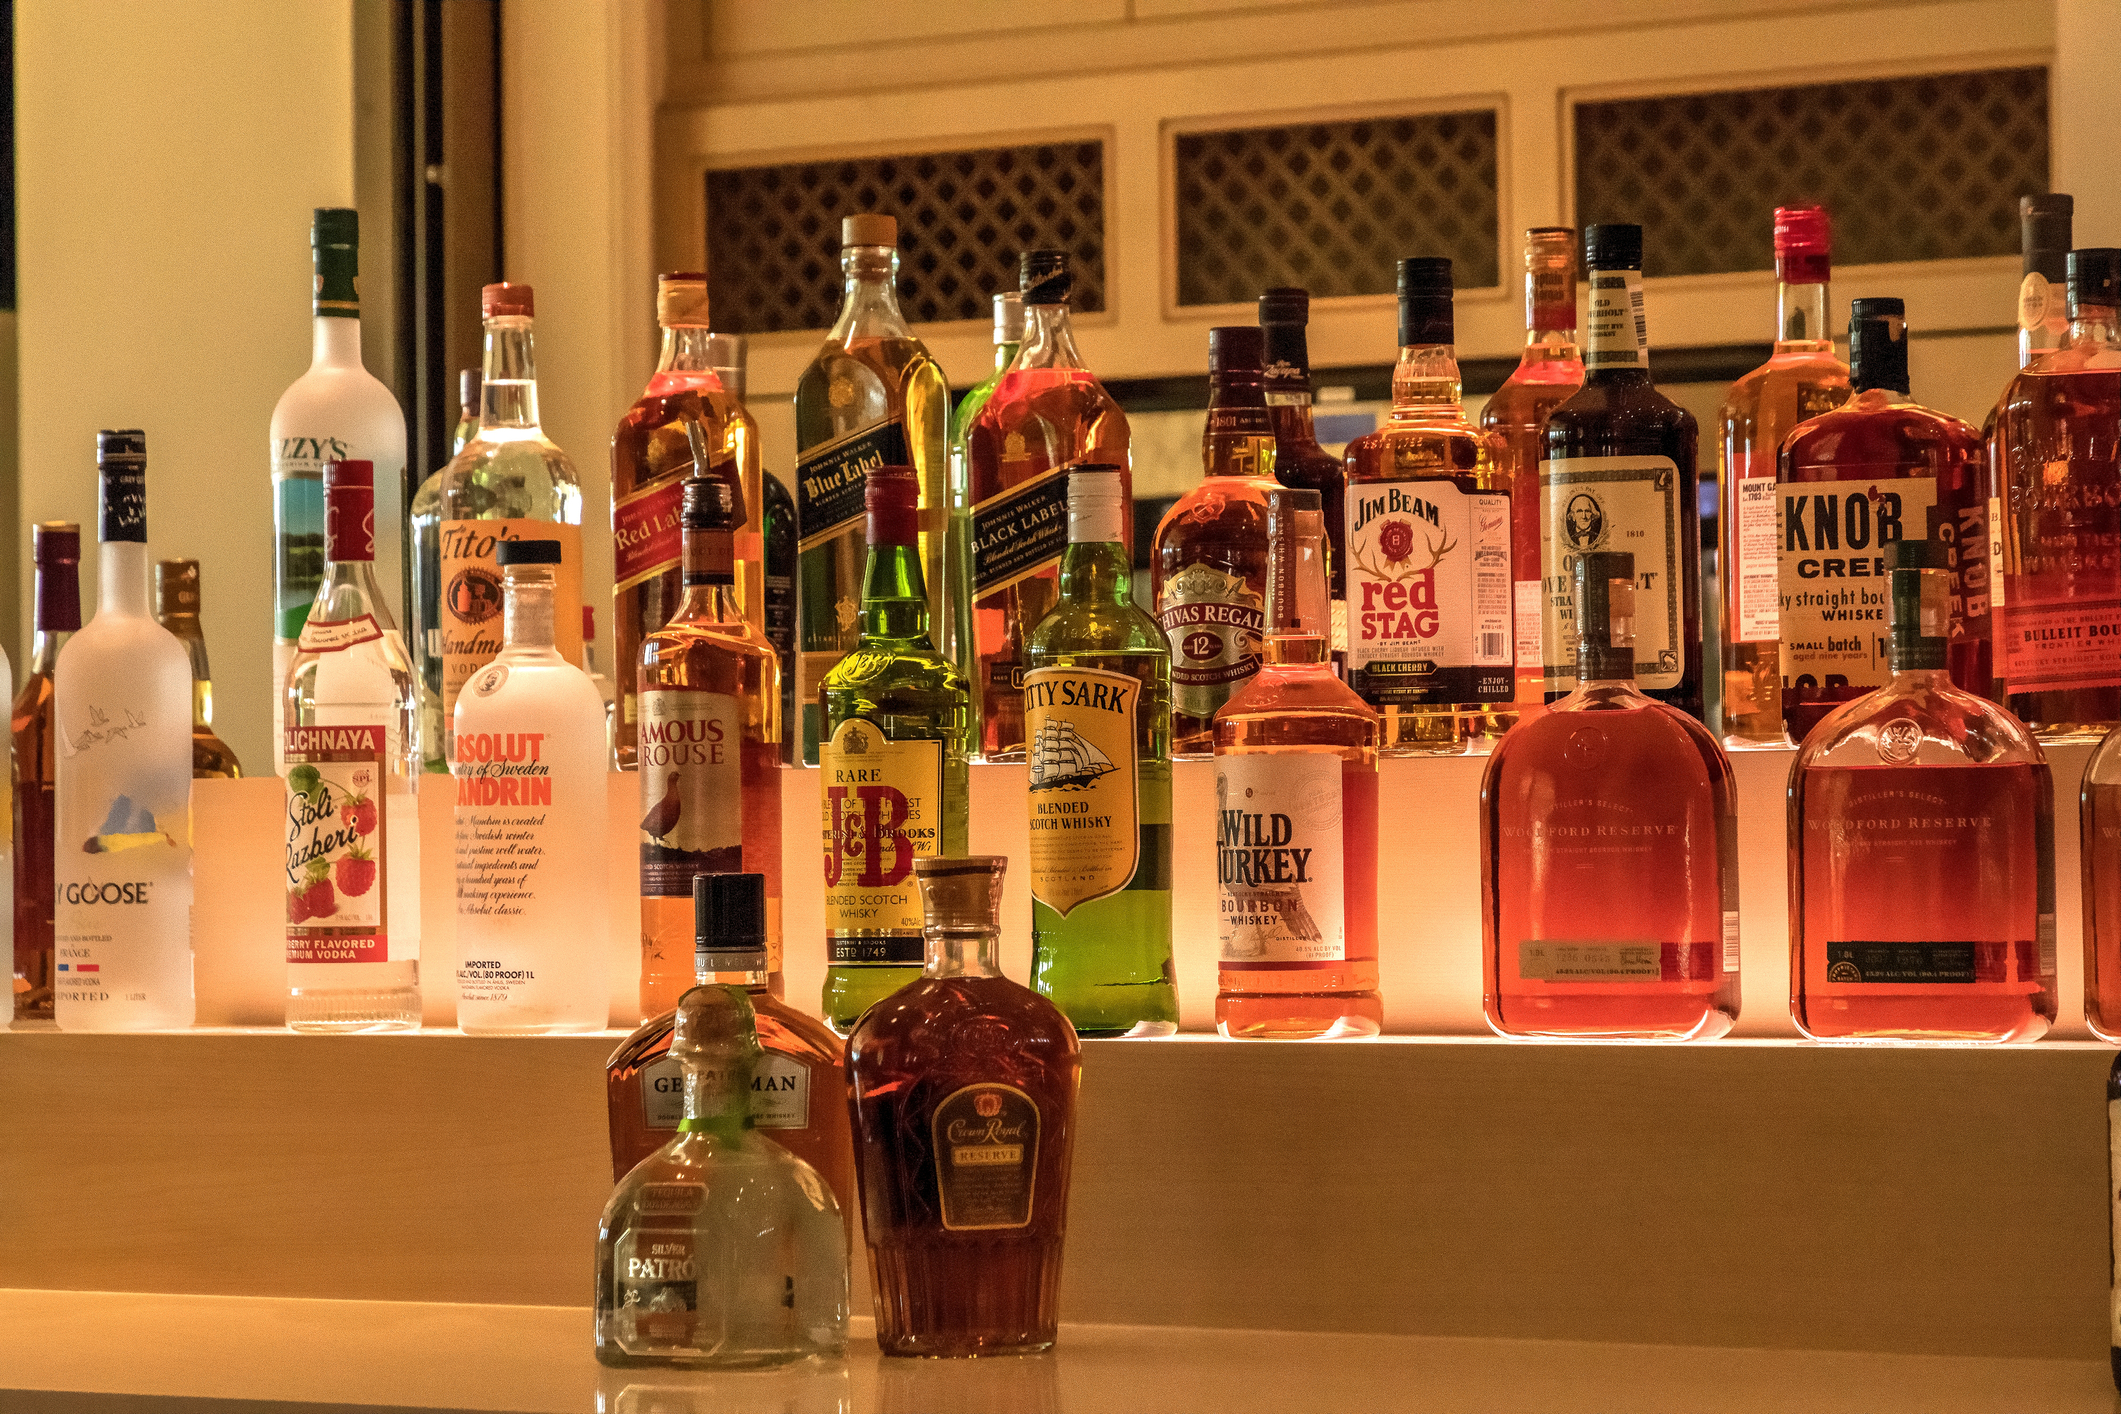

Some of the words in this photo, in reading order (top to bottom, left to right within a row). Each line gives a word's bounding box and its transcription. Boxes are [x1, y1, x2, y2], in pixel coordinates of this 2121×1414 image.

[1216, 416, 1236, 427] 1801
[842, 441, 872, 457] WALKER
[804, 473, 842, 502] Blue
[840, 450, 884, 485] Label
[1743, 483, 1766, 493] MOUNT
[1354, 495, 1386, 531] JIM
[1388, 488, 1439, 528] BEAM
[1478, 498, 1502, 507] QUALITY
[982, 510, 1015, 532] JOHNNIE
[1016, 495, 1047, 513] WALKER
[971, 522, 1019, 554] BLACK
[1021, 500, 1070, 530] LABEL
[1785, 492, 1903, 552] KNOB
[615, 520, 651, 550] Red
[1626, 530, 1645, 538] 1810
[441, 524, 521, 561] Tito'
[1959, 505, 1990, 618] KNOB
[1277, 567, 1285, 618] BOURBON
[1361, 568, 1438, 611] red
[1796, 587, 1856, 611] straight
[1205, 604, 1264, 631] REGAL
[1822, 609, 1884, 621] WHISKE
[1361, 611, 1439, 640] STAG
[2024, 626, 2082, 642] BULLEIT
[1193, 636, 1210, 655] 12
[1790, 642, 1825, 651] SMALL
[1827, 635, 1862, 652] batch
[1793, 652, 1816, 662] aged
[1818, 652, 1839, 660] nine
[1842, 652, 1868, 662] years
[1223, 661, 1255, 677] WHISKY
[1372, 663, 1396, 673] BLACK
[1397, 662, 1428, 672] CHERRY
[1478, 685, 1509, 694] CHILLED
[1062, 680, 1128, 714] SARK
[476, 759, 492, 785] of
[490, 758, 550, 778] Sweden
[836, 768, 883, 783] RARE
[289, 786, 335, 843] Stoli
[1037, 802, 1089, 814] BLENDED
[511, 813, 546, 826] created
[1061, 815, 1112, 829] WHISKY
[1908, 816, 1992, 830] RESERVE
[1222, 809, 1293, 847] WILD
[1596, 824, 1678, 836] RESERVE
[505, 831, 535, 841] winter
[495, 843, 518, 855] well
[517, 845, 546, 856] water.
[474, 858, 518, 873] ingredients
[518, 858, 540, 870] and
[1217, 840, 1313, 888] TURKEY
[1040, 874, 1095, 882] SCOTLAND
[66, 881, 150, 905] GOOSE
[859, 894, 908, 905] SCOTCH
[493, 903, 527, 916] classic.
[1221, 899, 1298, 913] BOURBON
[839, 908, 879, 919] WHISKY
[1230, 915, 1278, 925] WHISKEY
[314, 938, 376, 949] FLAVORED
[316, 949, 357, 960] VODKA
[862, 947, 887, 957] 1749
[464, 960, 502, 969] IMPORTED
[495, 970, 525, 980] PROOF)
[947, 1118, 986, 1144] Crown
[976, 1117, 1028, 1145] Royal
[960, 1150, 1017, 1162] RESERVE
[651, 1243, 686, 1255] SILVER
[628, 1253, 698, 1280] PATRÓ
